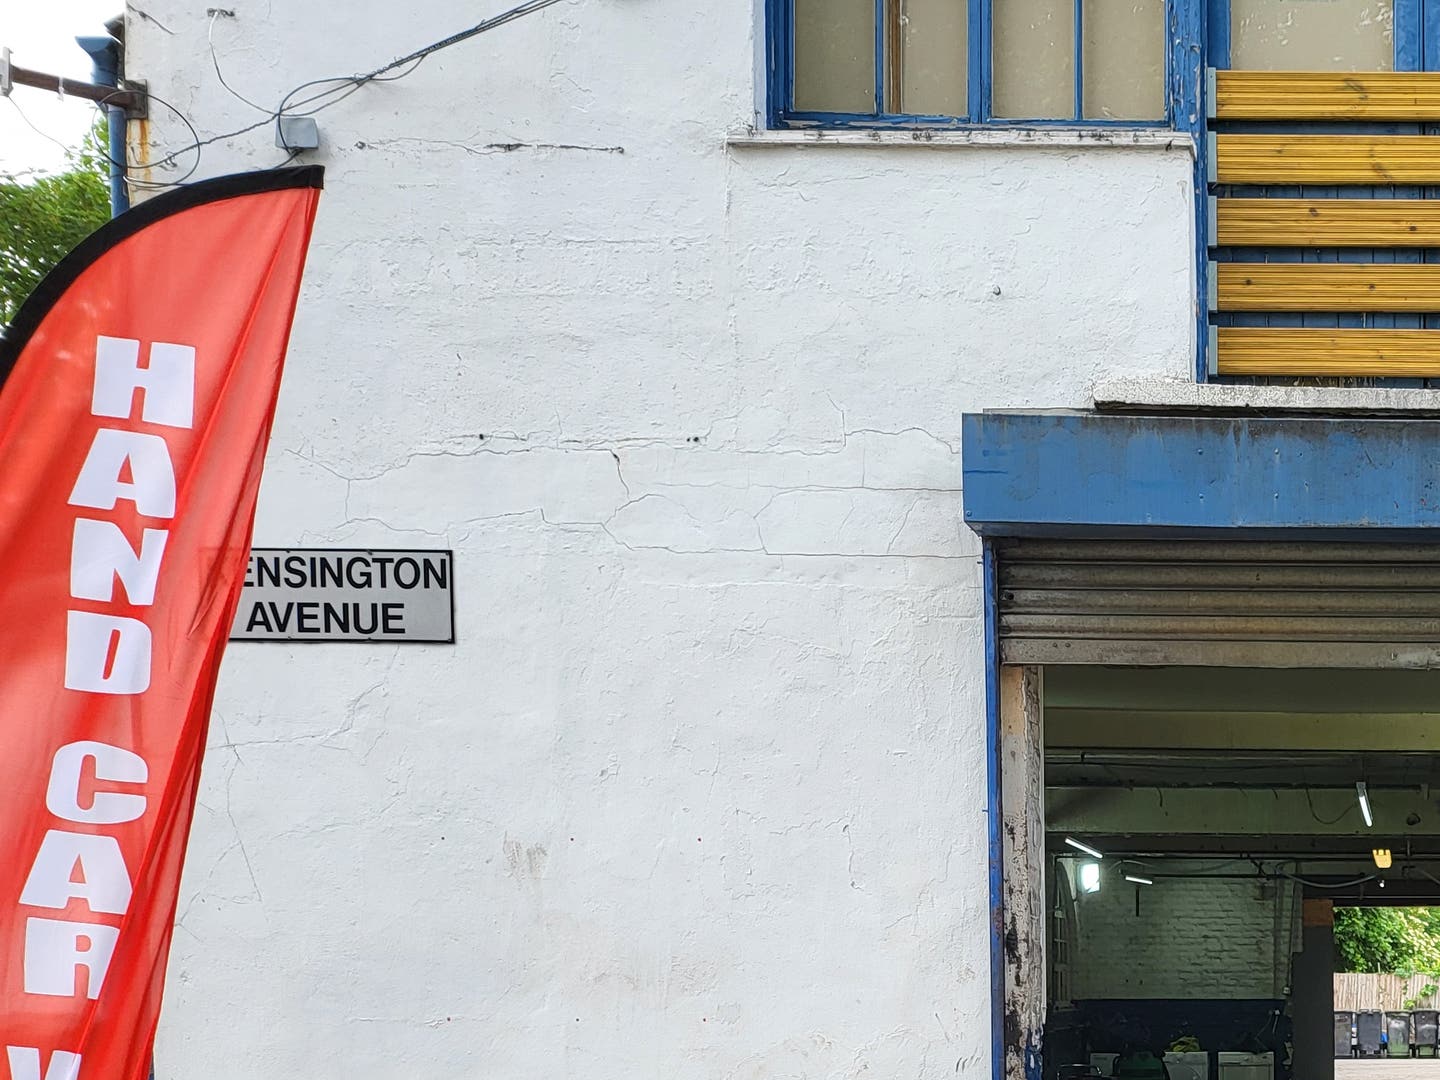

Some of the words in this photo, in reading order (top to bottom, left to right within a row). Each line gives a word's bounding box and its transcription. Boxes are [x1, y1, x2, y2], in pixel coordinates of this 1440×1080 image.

[64, 334, 196, 696] HAND
[242, 555, 448, 590] NSINGTON
[245, 601, 406, 635] AVENUE
[18, 739, 148, 1000] CAR
